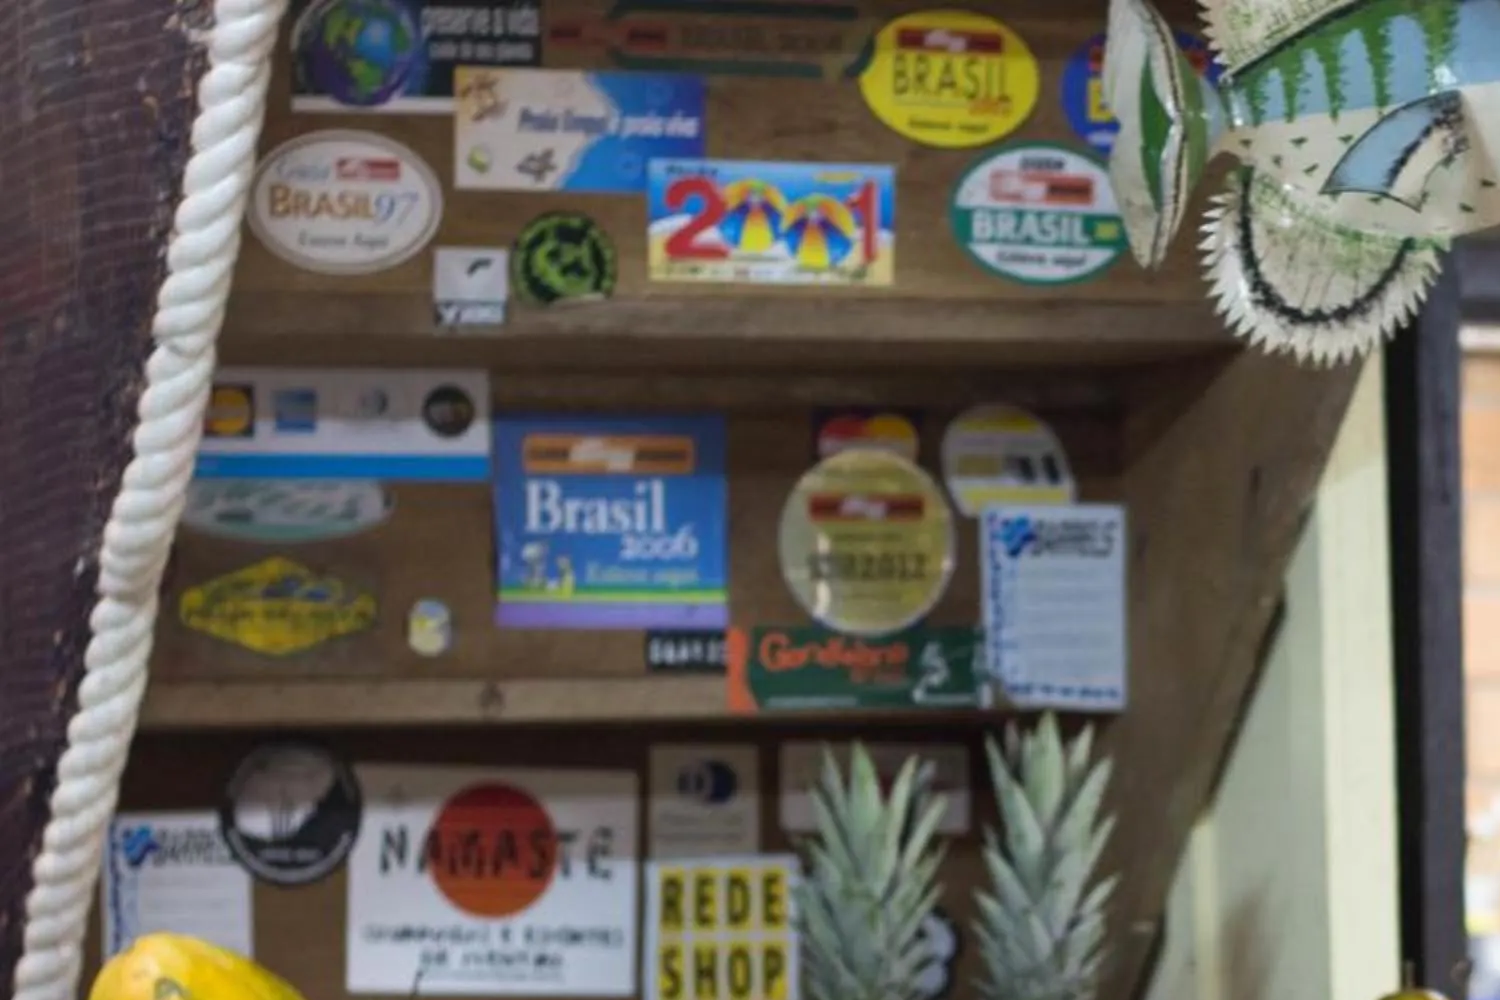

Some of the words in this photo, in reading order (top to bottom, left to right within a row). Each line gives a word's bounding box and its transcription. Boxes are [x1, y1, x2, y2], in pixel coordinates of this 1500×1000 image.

[893, 52, 1009, 100] BRASIL
[971, 209, 1090, 245] BRASIL
[524, 477, 666, 535] Brasil
[618, 521, 700, 562] 2006
[661, 870, 787, 929] REDE
[661, 944, 787, 1000] SHOP
